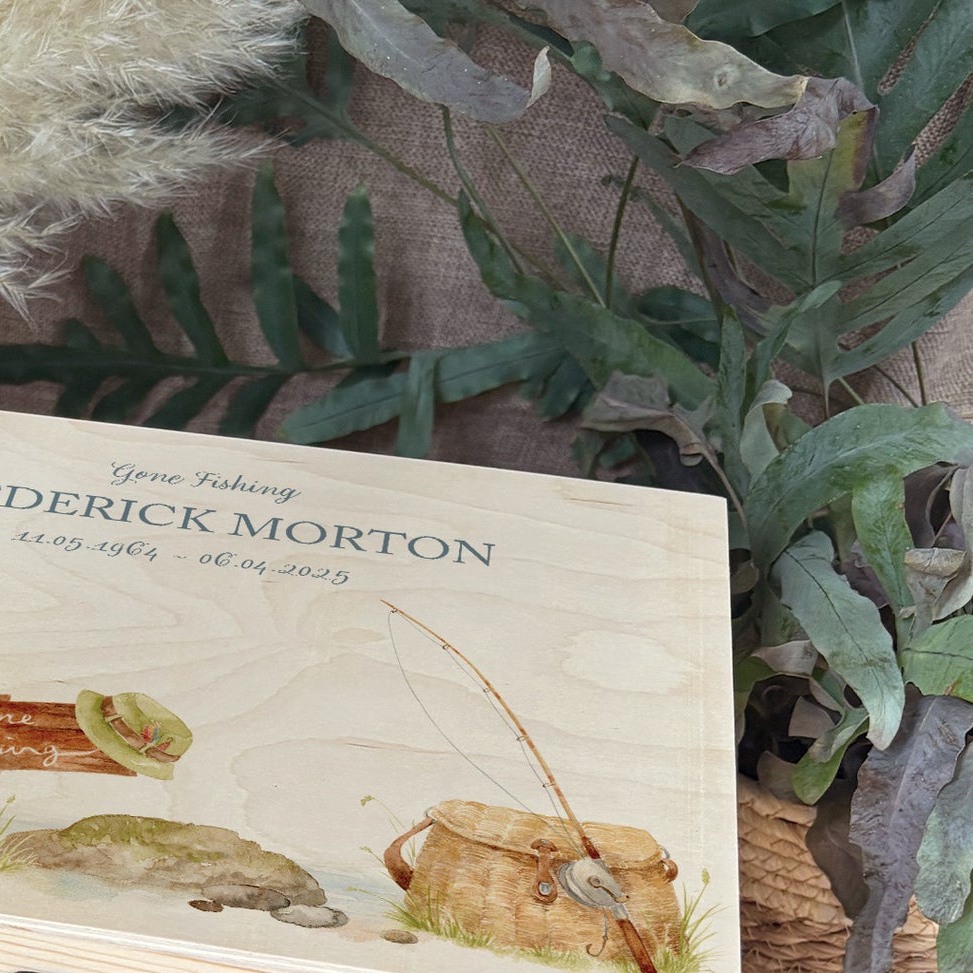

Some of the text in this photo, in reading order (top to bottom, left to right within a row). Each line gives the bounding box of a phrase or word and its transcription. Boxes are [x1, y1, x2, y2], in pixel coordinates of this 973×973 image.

[111, 461, 302, 504] Gone Fishing
[11, 530, 158, 562] 11.05.1964
[199, 551, 350, 586] 06.04.2025
[227, 512, 496, 567] MORTON
